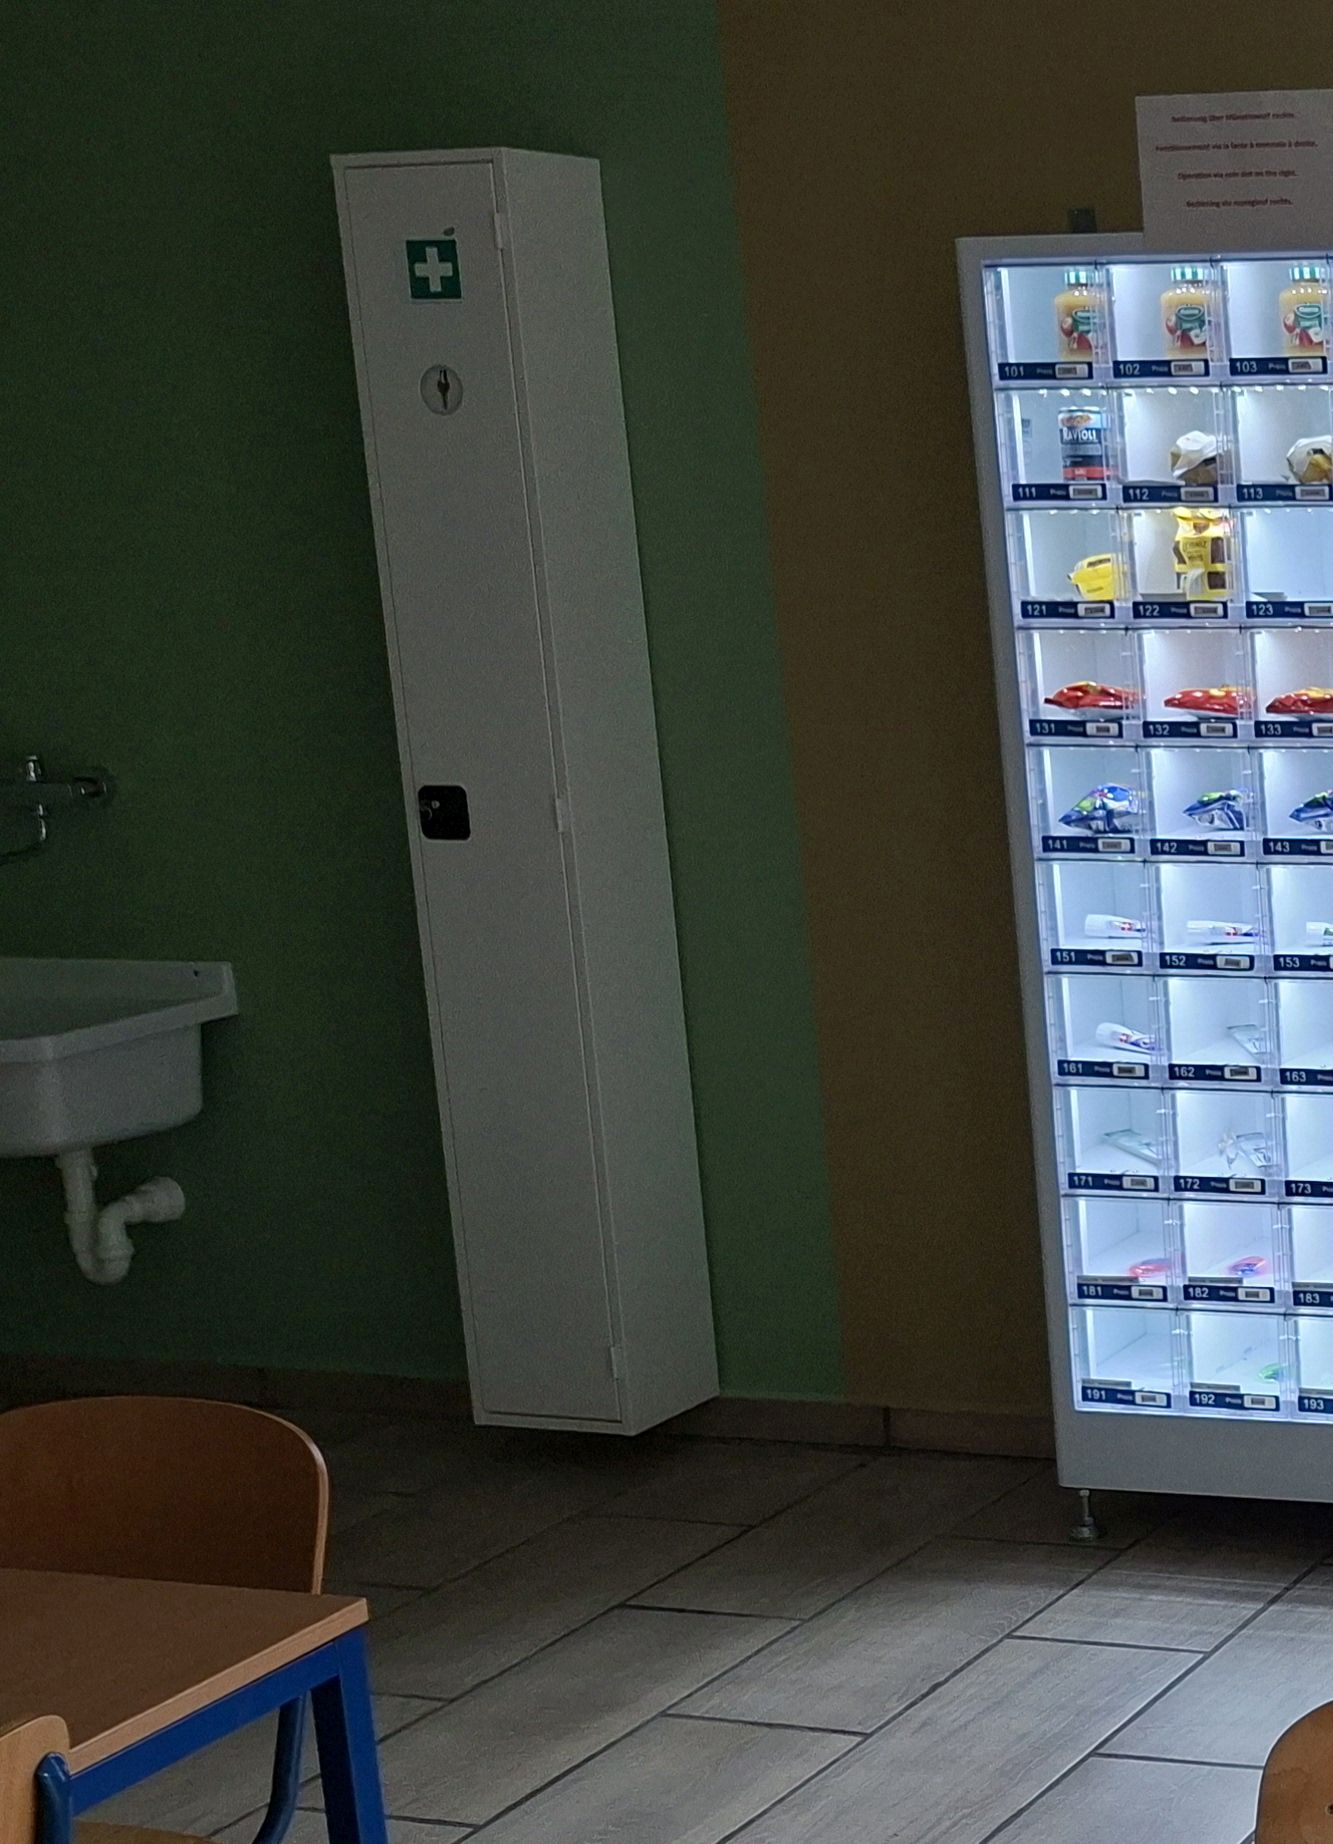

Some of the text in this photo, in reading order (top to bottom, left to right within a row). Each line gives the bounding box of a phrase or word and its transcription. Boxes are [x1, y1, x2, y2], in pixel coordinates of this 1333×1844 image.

[1004, 366, 1025, 377] 101
[1118, 364, 1141, 375] 102
[1235, 361, 1258, 372] 103
[1018, 487, 1037, 497] 111
[1128, 488, 1150, 500] 112
[1242, 488, 1264, 499] 113
[1026, 604, 1047, 615] 121
[1138, 605, 1160, 616] 122
[1251, 604, 1274, 615] 123
[1035, 723, 1056, 733] 131
[1148, 724, 1170, 735] 132
[1260, 724, 1282, 735] 133
[1047, 839, 1068, 848] 141
[1156, 842, 1178, 852] 142
[1268, 842, 1290, 852] 143
[1055, 951, 1076, 961] 151
[1164, 955, 1186, 966] 152
[1278, 957, 1300, 967] 153
[1062, 1063, 1083, 1073] 161
[1173, 1067, 1195, 1077] 162
[1285, 1071, 1307, 1082] 163
[1072, 1176, 1093, 1186] 171
[1179, 1179, 1200, 1189] 172
[1290, 1183, 1312, 1193] 173
[1082, 1286, 1102, 1295] 181
[1188, 1287, 1209, 1297] 182
[1298, 1293, 1320, 1303] 183
[1086, 1389, 1106, 1400] 191
[1194, 1394, 1216, 1404] 192
[1303, 1399, 1325, 1409] 193
